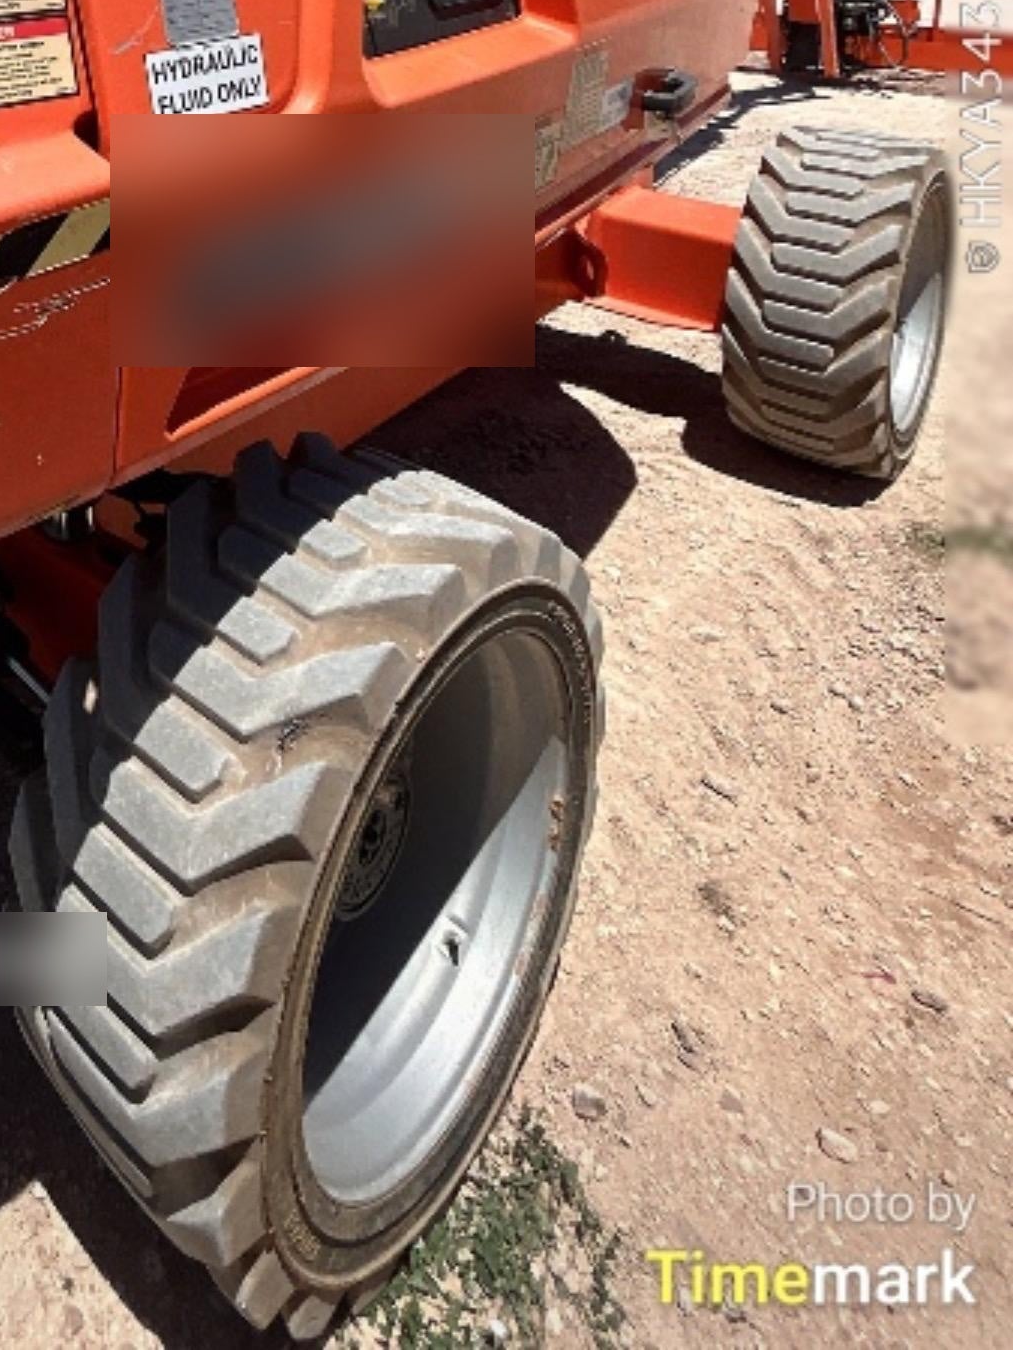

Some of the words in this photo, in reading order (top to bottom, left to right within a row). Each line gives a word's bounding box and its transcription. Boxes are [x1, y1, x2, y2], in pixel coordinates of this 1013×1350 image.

[151, 44, 259, 85] HYDRAULIC
[157, 86, 214, 114] FLUID
[216, 74, 262, 104] ONLY
